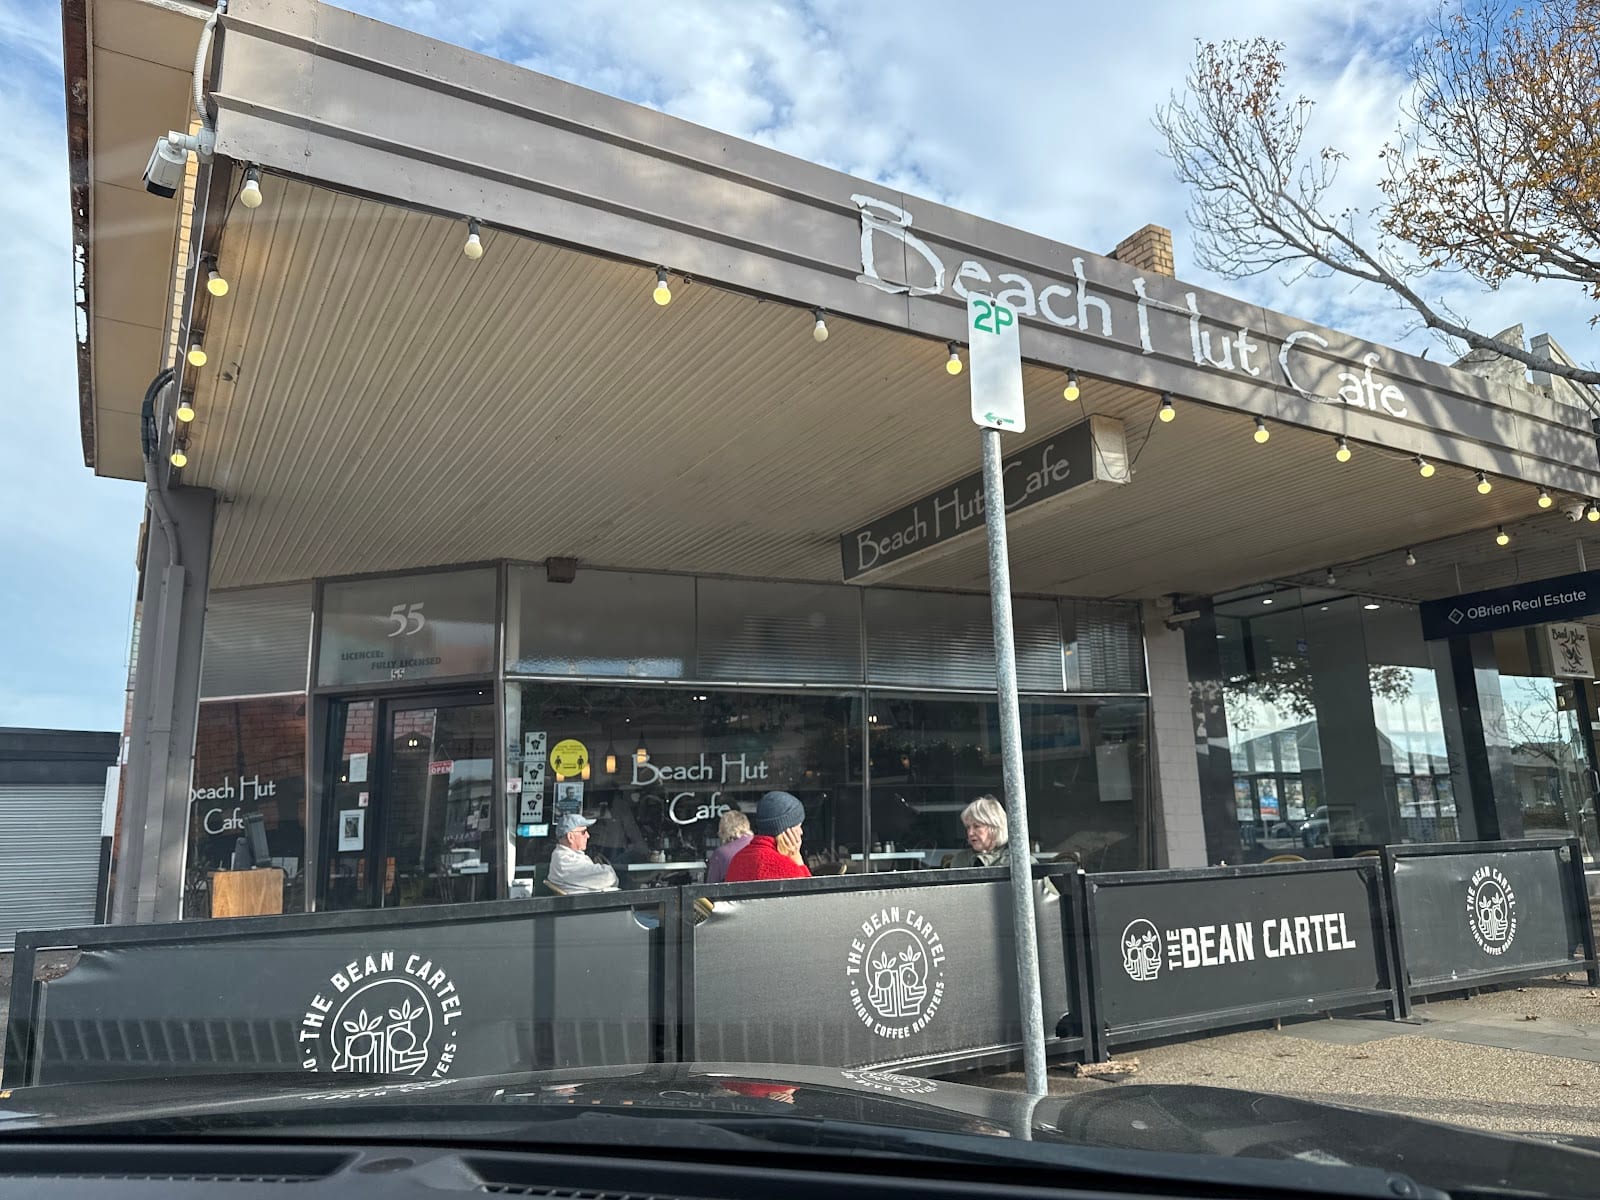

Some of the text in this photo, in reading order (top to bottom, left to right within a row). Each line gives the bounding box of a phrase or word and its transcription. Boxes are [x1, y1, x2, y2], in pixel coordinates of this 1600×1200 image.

[851, 193, 1407, 418] Beach Hut Cafe
[972, 299, 1013, 335] 2P
[856, 507, 927, 571] Beach
[935, 487, 985, 538] Hut
[387, 602, 426, 637] 55
[1467, 589, 1587, 620] OBrien Real Estate
[371, 656, 442, 670] FULLY LICENSED
[240, 774, 276, 801] Hut
[431, 766, 451, 774] OPEN
[631, 753, 769, 786] Beach Hut
[1467, 866, 1516, 911] THE BEAN CARTEL
[846, 906, 946, 975] THE BEAN CARTEL
[1166, 913, 1356, 971] THE BEAN CARTEL
[299, 951, 462, 1043] THE BEAN CARTEL
[850, 981, 945, 1039] ORIGIN COFFEE ROASTERS
